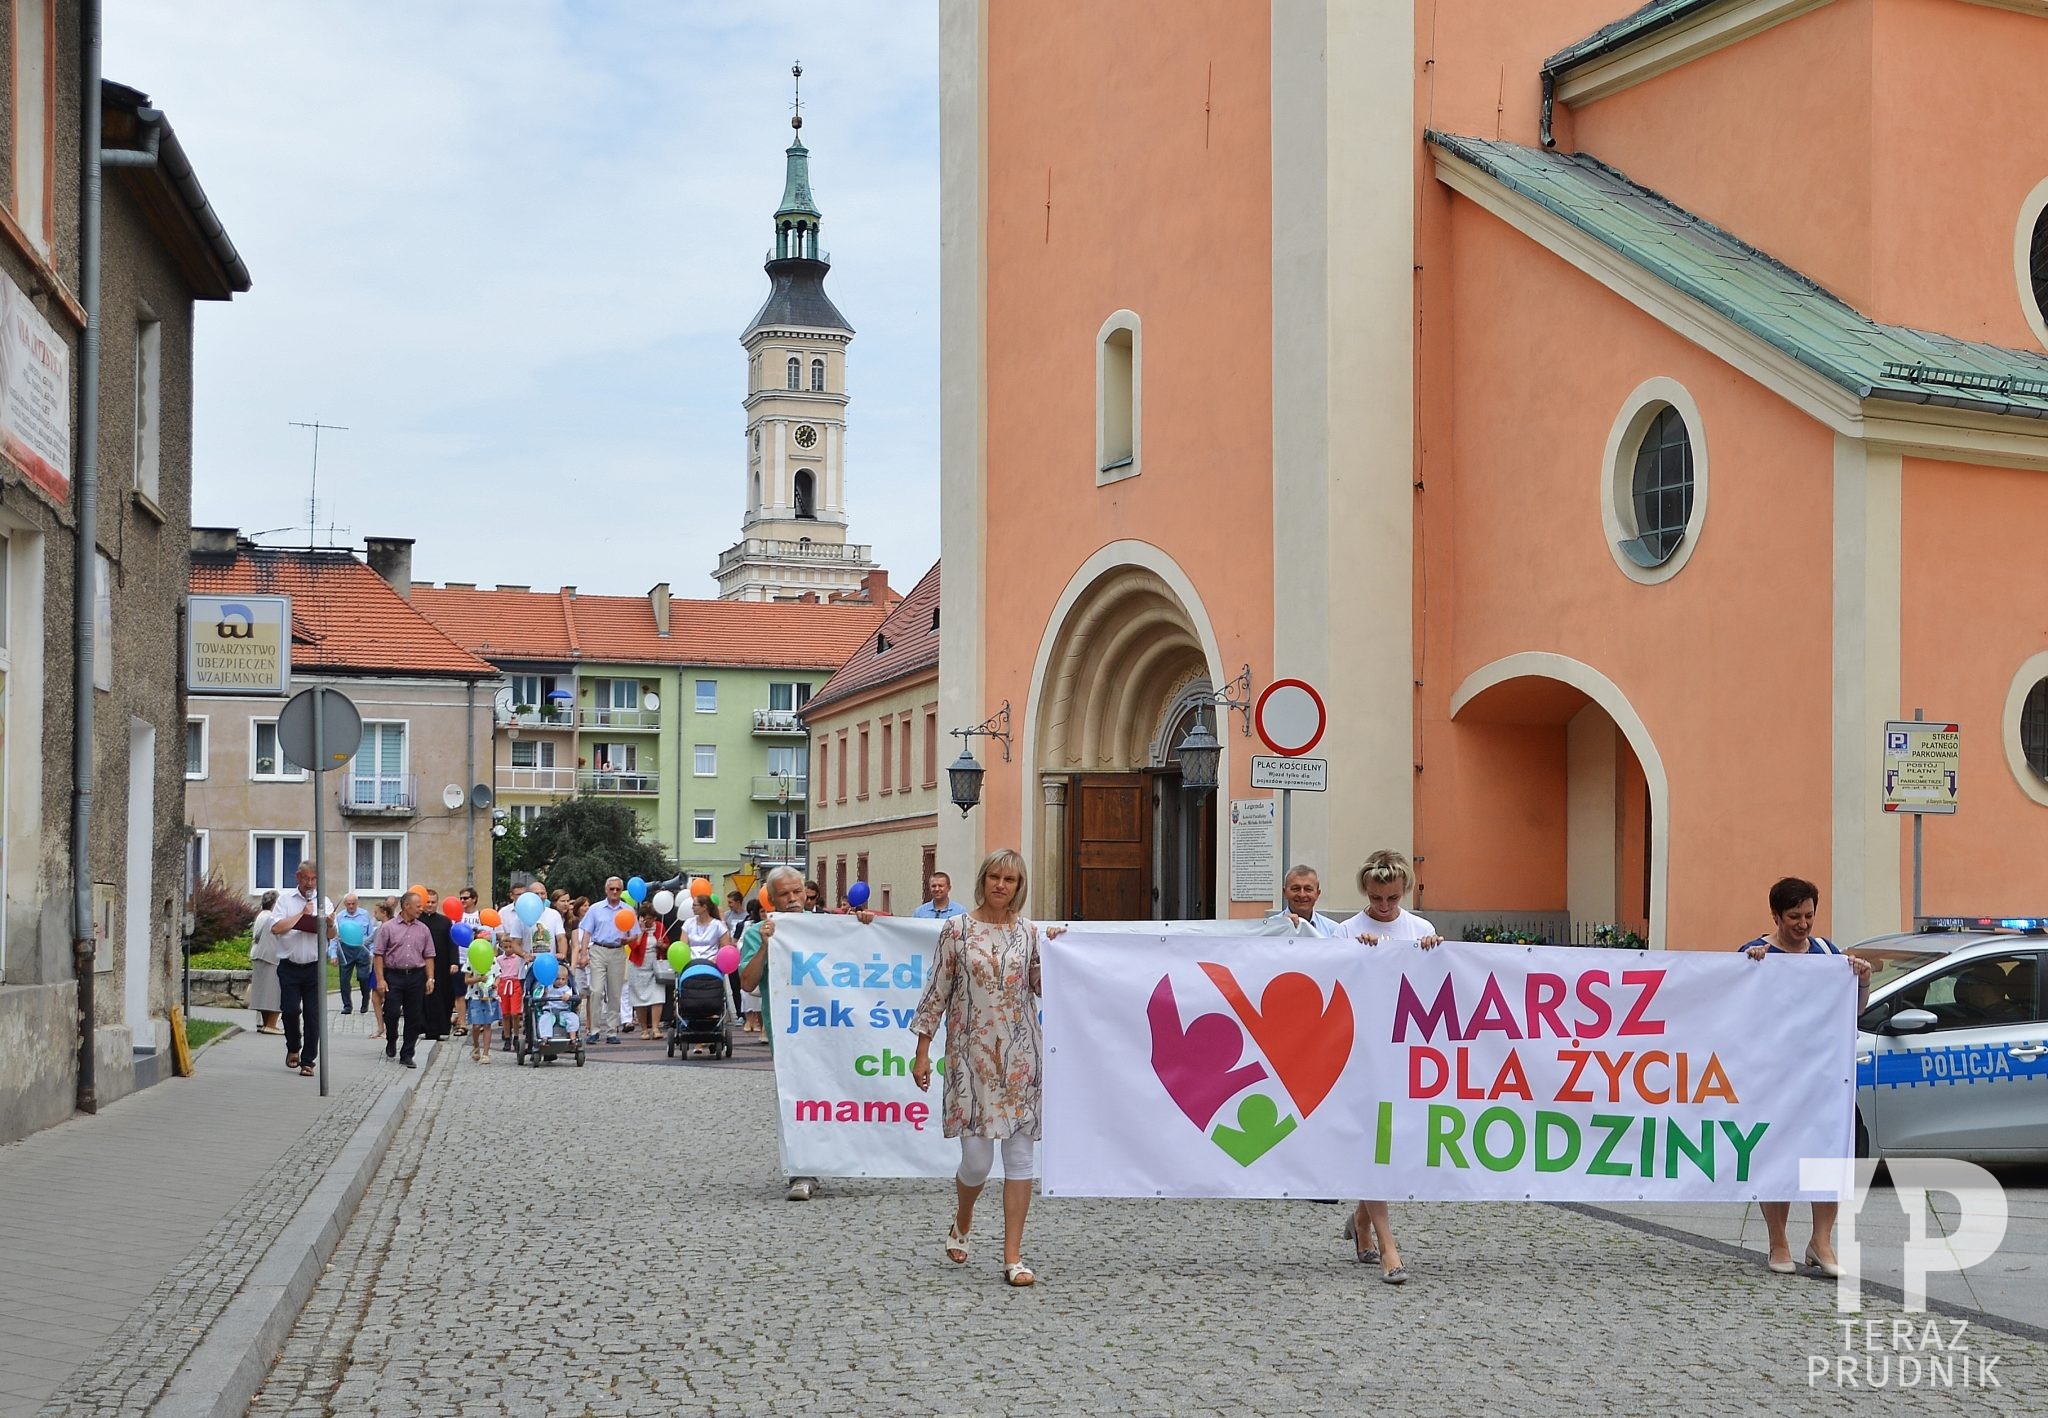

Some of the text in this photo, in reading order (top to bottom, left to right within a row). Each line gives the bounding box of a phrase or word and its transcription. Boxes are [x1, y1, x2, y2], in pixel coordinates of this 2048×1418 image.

[195, 643, 276, 656] TOWARZYSTWO
[197, 671, 273, 685] WZAJEMNYCH
[1257, 761, 1322, 771] PLAC KOŚCIELNY
[1912, 750, 1958, 758] PARKOWANIA
[1284, 779, 1322, 787] uprawnionych
[791, 951, 933, 989] Każd
[787, 999, 854, 1034] jak
[1391, 969, 1667, 1045] MARSZ
[1408, 1038, 1740, 1104] DLA ŻYCIA
[1920, 1051, 2010, 1078] POLICJA
[796, 1100, 930, 1131] mamę
[1374, 1100, 1770, 1183] I RODZINY
